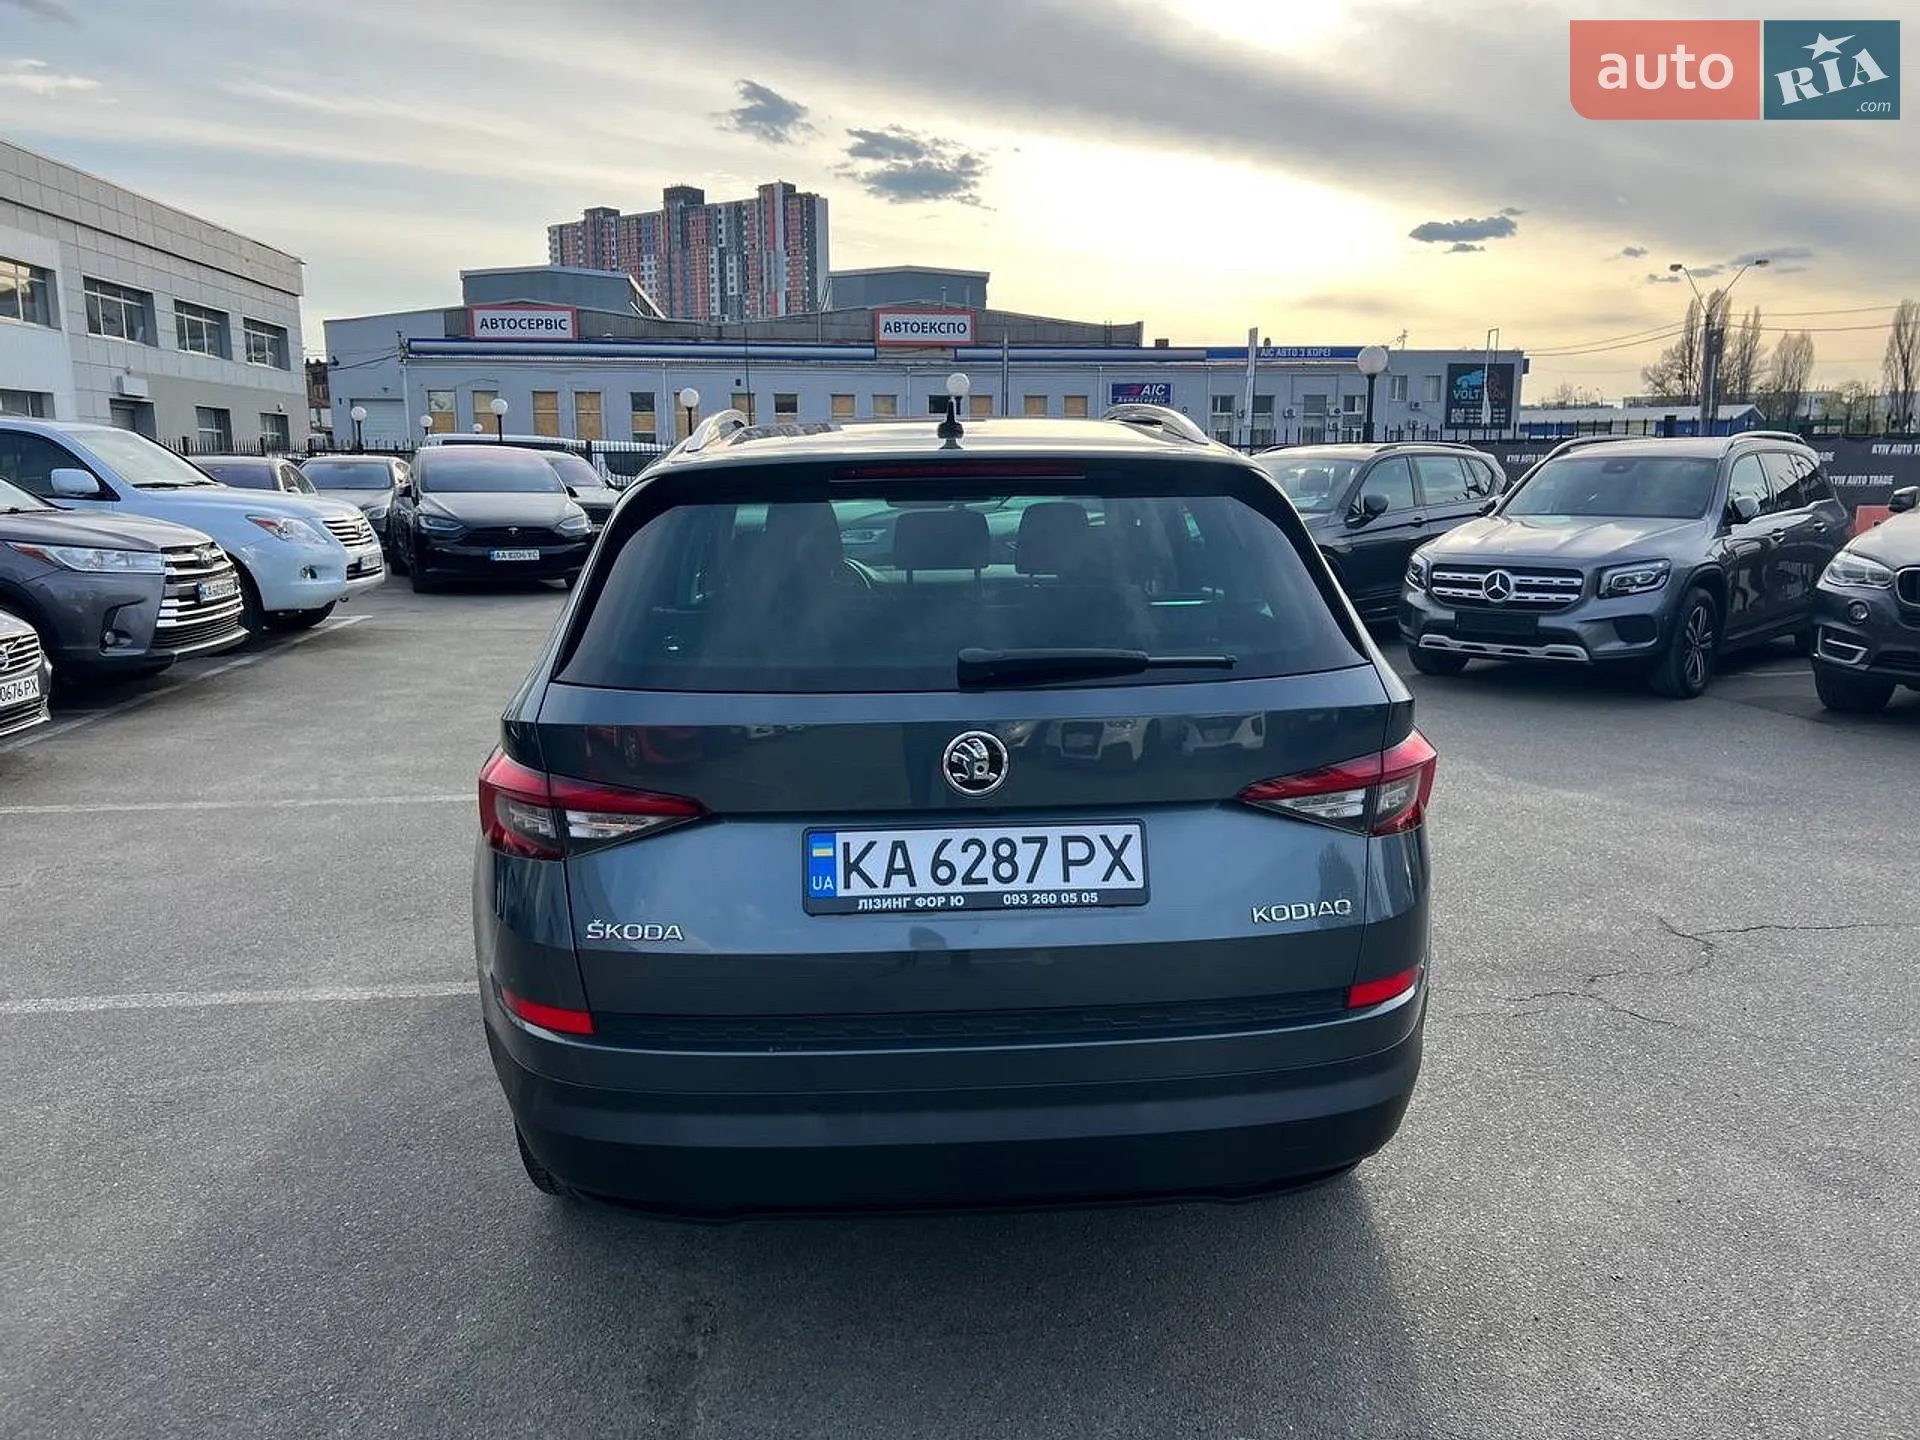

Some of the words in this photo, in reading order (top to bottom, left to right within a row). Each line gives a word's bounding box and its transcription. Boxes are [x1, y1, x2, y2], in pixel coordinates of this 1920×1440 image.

[480, 318, 568, 330] АВТОСЕРВІС
[883, 321, 967, 334] АВТОЕКСПО
[1891, 444, 1912, 454] AUTO
[1846, 475, 1868, 485] AUTO
[1868, 475, 1894, 485] TRADE
[24, 678, 39, 695] PX
[842, 839, 918, 889] KA
[930, 835, 1050, 886] 6287
[1059, 834, 1137, 883] PX
[812, 877, 834, 891] UA
[857, 898, 910, 911] ЛІЗИНГ
[914, 896, 946, 909] ФОР
[949, 896, 965, 907] Ю
[1002, 894, 1028, 906] 093
[1030, 892, 1056, 905] 260
[1058, 892, 1077, 904] 05
[1079, 890, 1098, 903] 05
[1251, 898, 1352, 923] KODIAQ
[586, 919, 684, 940] ŠKODA
